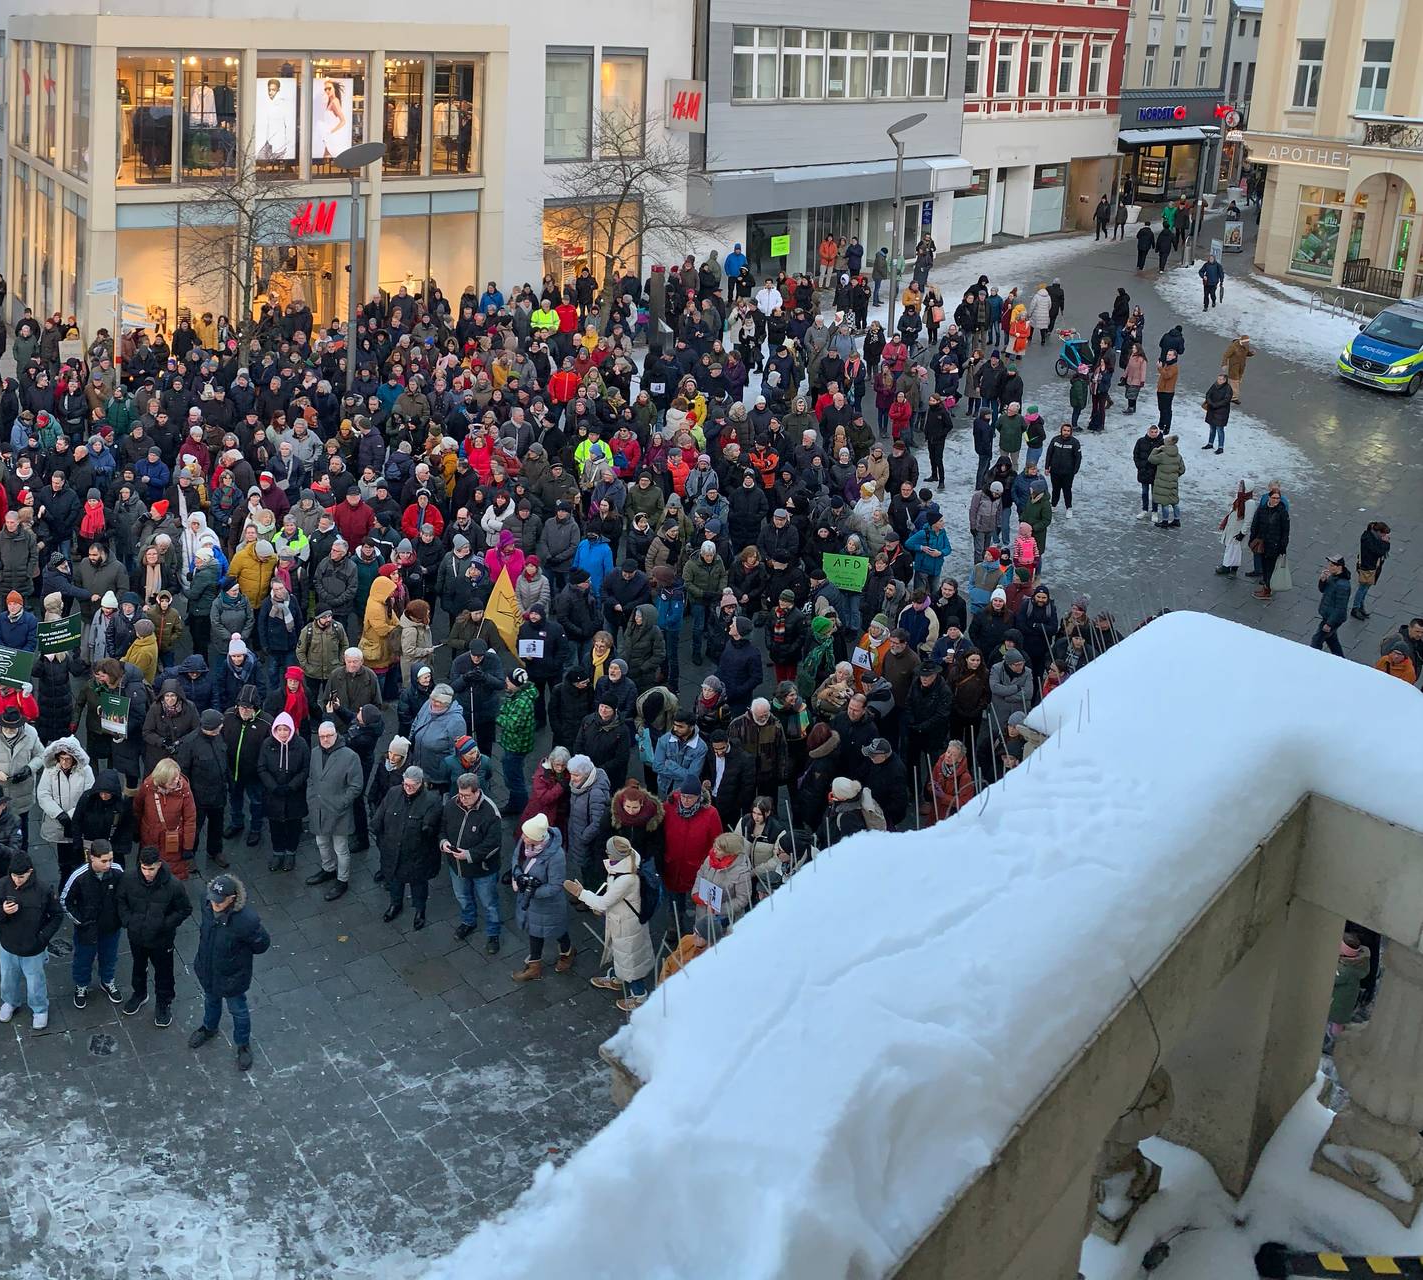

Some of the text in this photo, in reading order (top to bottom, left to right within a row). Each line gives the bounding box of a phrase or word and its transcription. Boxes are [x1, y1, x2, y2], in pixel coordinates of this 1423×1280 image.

[672, 91, 702, 122] H&M
[289, 200, 337, 237] H&M
[1361, 345, 1392, 357] POLIZEI
[833, 558, 861, 569] AFD
